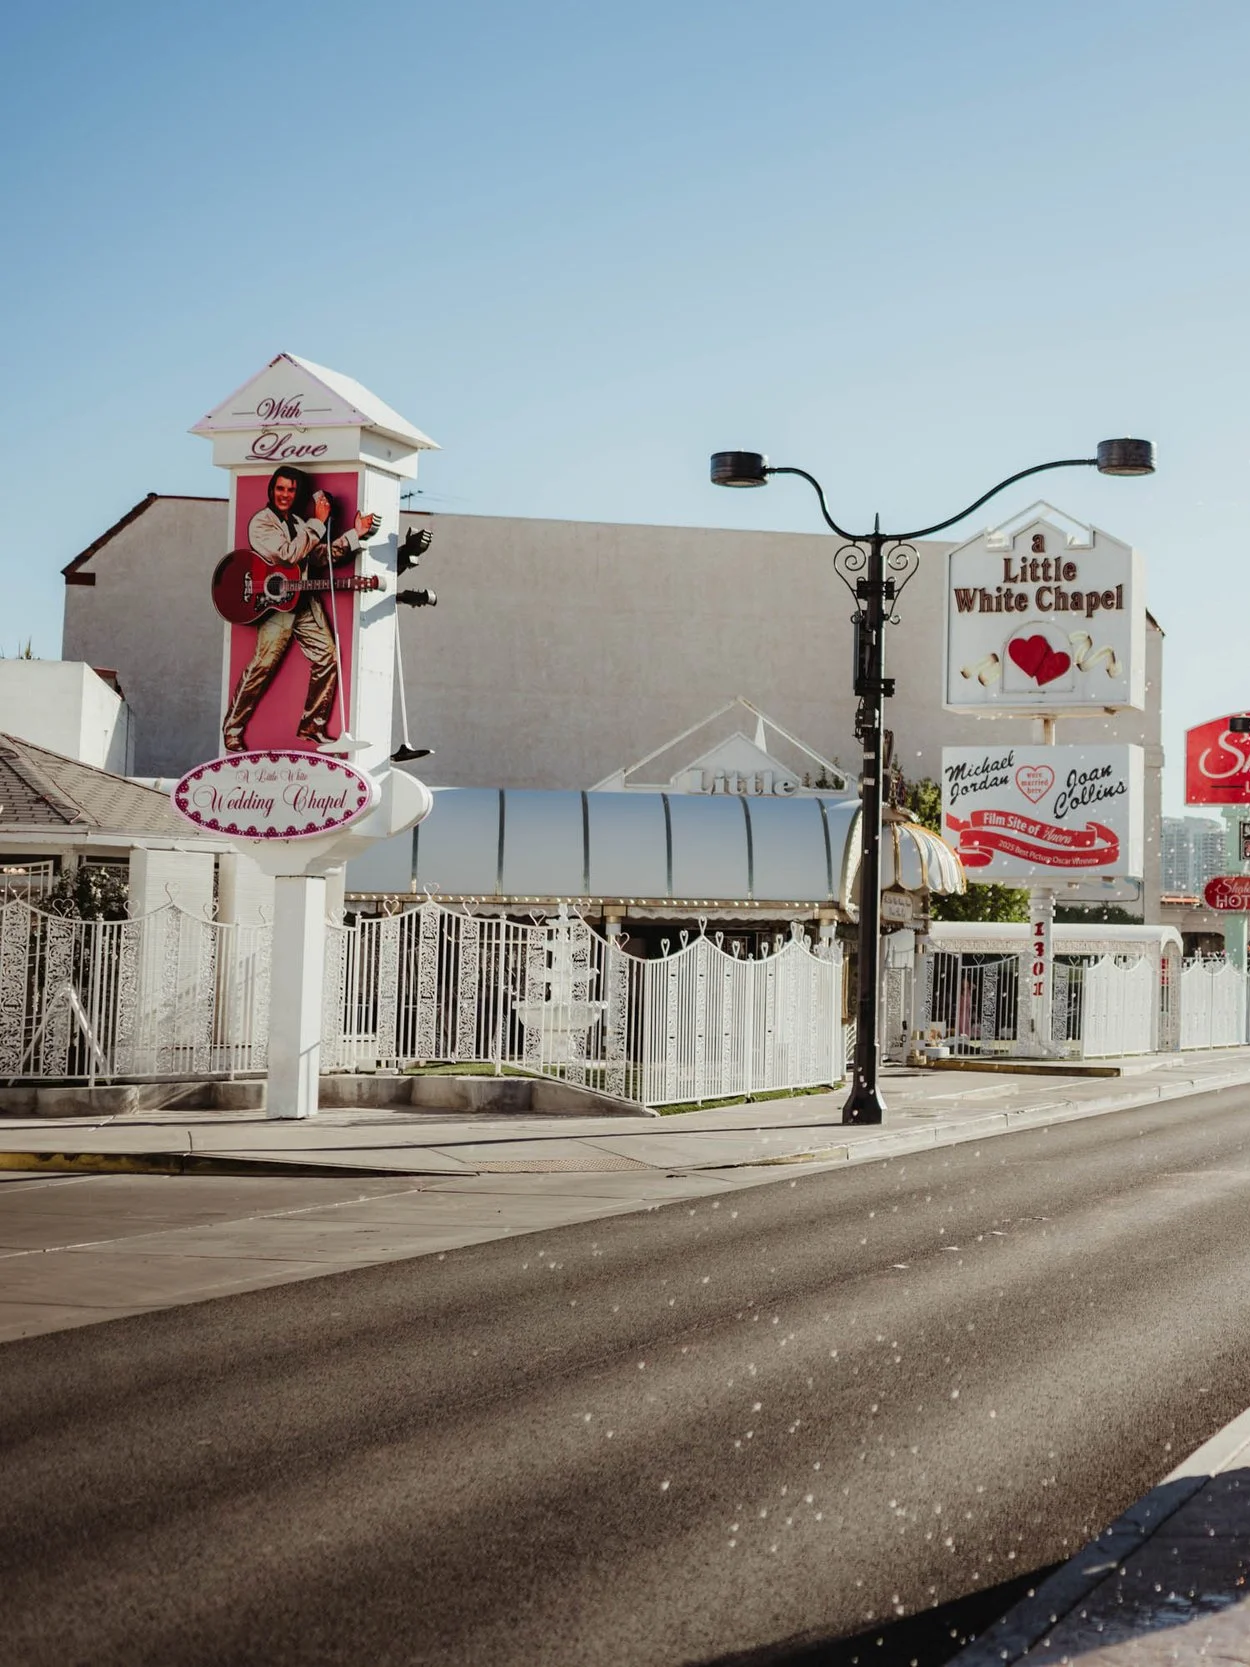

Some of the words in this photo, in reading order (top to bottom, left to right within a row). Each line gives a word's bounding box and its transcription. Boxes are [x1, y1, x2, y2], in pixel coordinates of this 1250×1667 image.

[257, 394, 304, 420] With
[245, 432, 328, 461] Love
[1031, 533, 1045, 553] a
[1003, 556, 1077, 583] Little
[954, 586, 1028, 613] White
[1035, 584, 1123, 618] Chapel
[254, 769, 279, 782] Little
[280, 769, 309, 782] White
[945, 750, 1014, 782] Michael
[688, 769, 798, 796] Little
[950, 774, 1009, 805] Jordan
[1066, 764, 1112, 798] Joan
[193, 785, 275, 817] Wedding
[283, 784, 348, 817] Chapel
[1053, 781, 1128, 819] Collins
[983, 812, 1005, 826] Film
[1008, 815, 1027, 832] Site
[1028, 825, 1040, 836] of
[998, 840, 1014, 851] 2025
[1015, 846, 1029, 857] Best
[1029, 852, 1052, 863] Picture
[1053, 856, 1071, 865] Oscar
[1033, 921, 1045, 996] 1301
